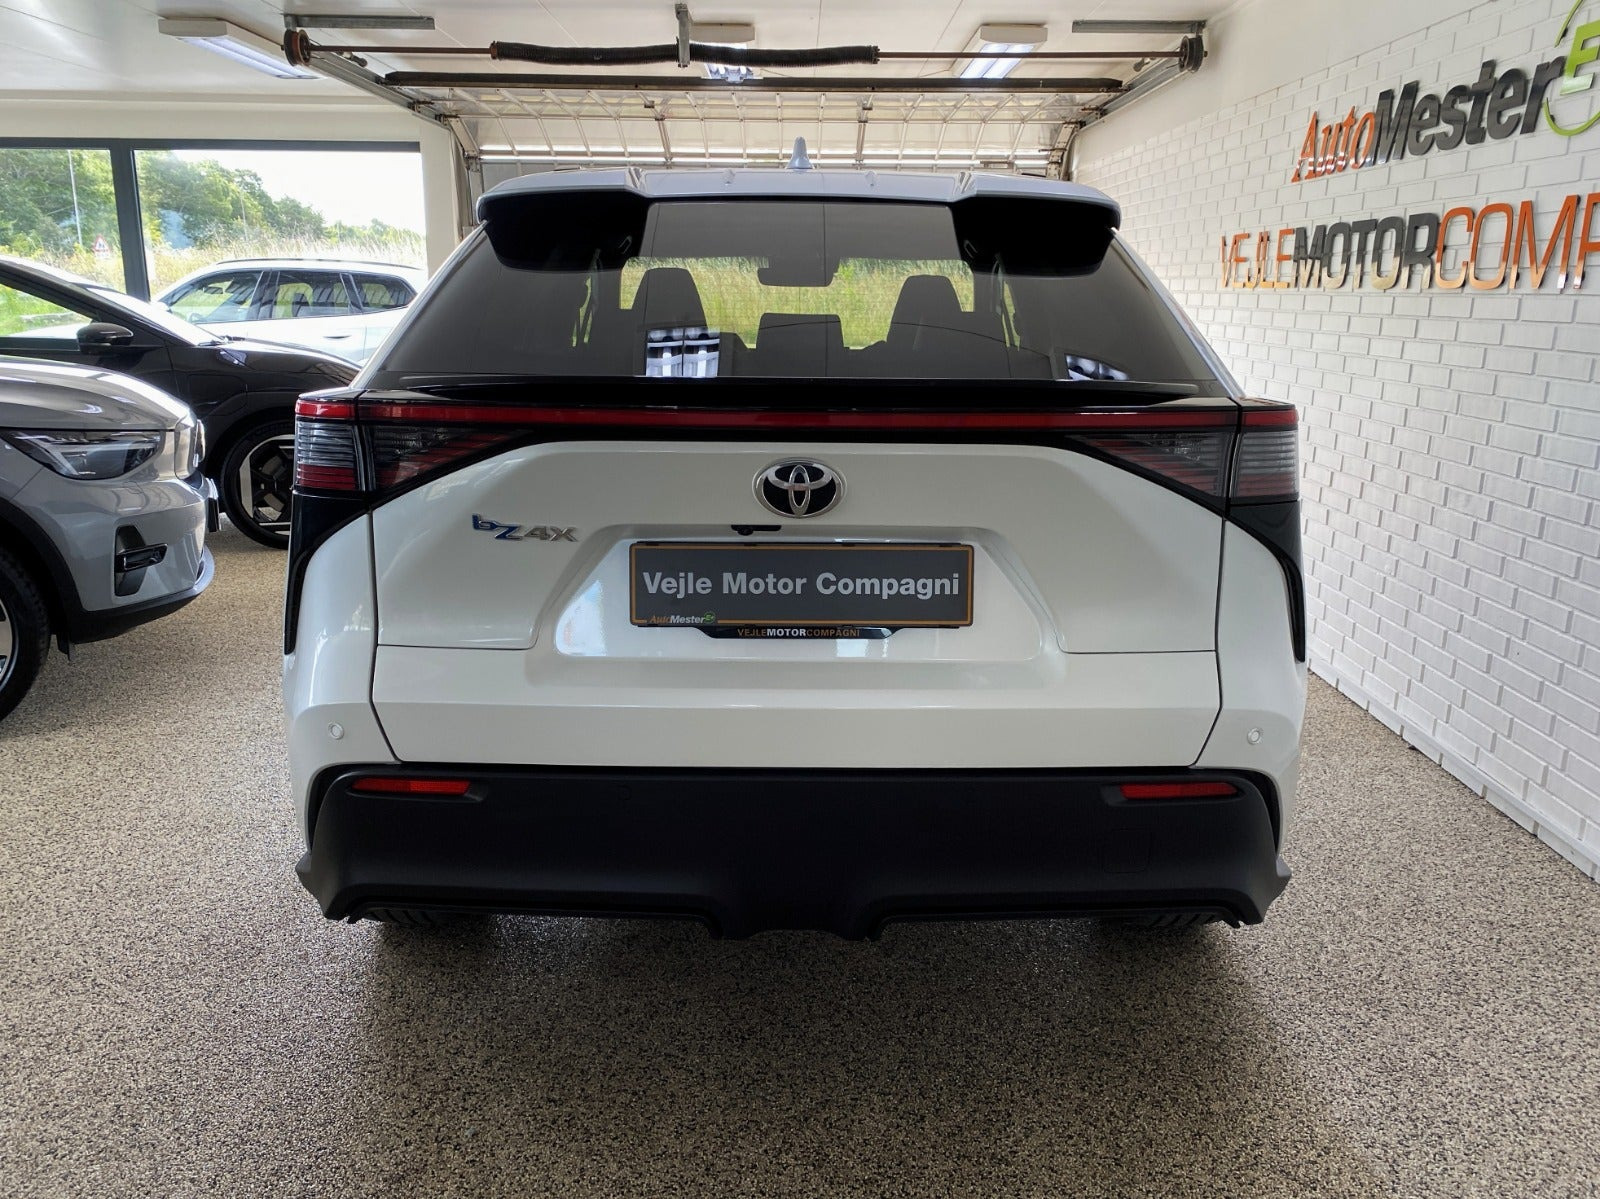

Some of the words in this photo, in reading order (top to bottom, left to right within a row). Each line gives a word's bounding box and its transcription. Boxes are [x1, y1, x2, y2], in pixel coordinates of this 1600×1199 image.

[642, 571, 713, 599] Vejle
[722, 571, 808, 596] Motor
[815, 571, 960, 600] Compagni
[737, 627, 860, 638] VEJLEMOTORCOMPAGNI
